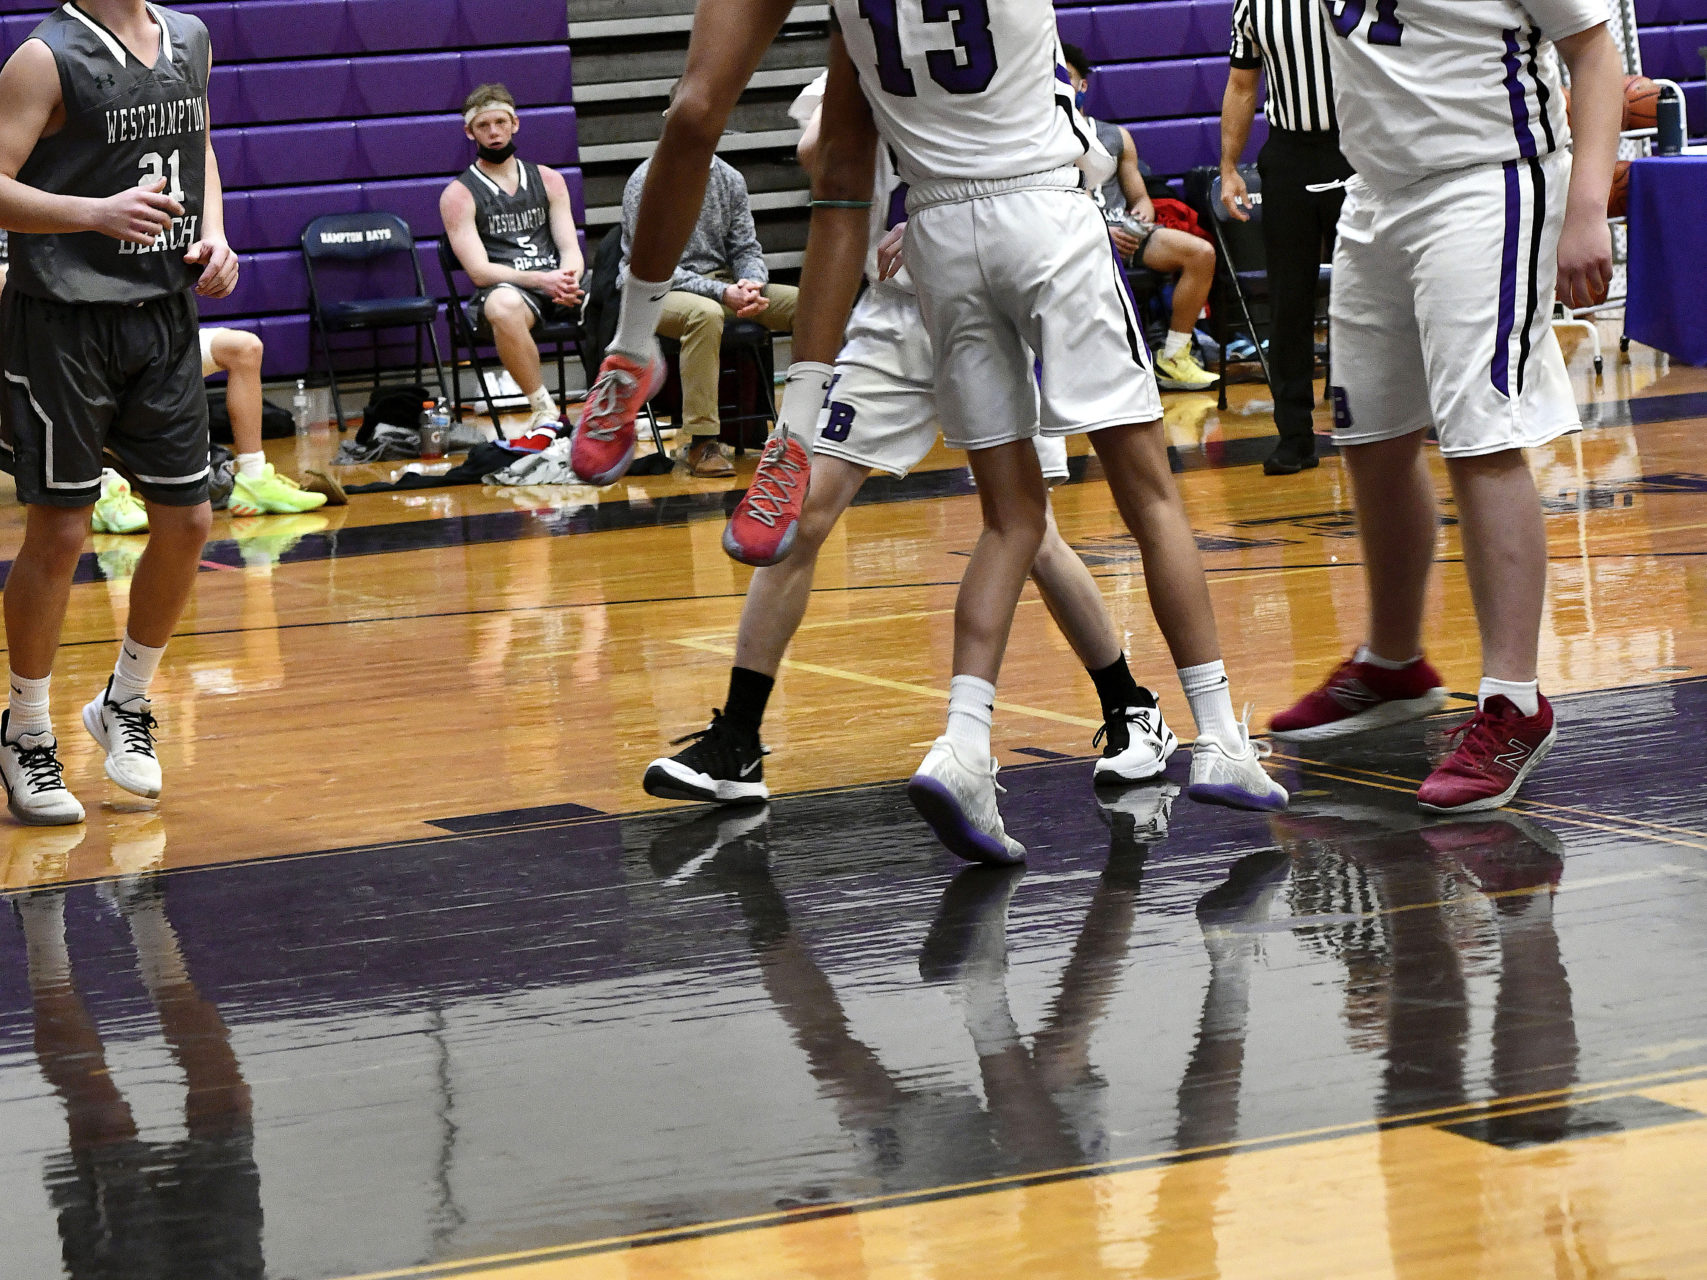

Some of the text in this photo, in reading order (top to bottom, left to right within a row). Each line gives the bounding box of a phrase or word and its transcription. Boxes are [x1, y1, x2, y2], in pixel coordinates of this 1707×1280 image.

[105, 96, 205, 144] WESTHAMPTON
[138, 149, 185, 202] 21
[118, 215, 198, 255] BACH
[320, 228, 392, 244] HAMPTON BAYS
[516, 235, 538, 257] 5
